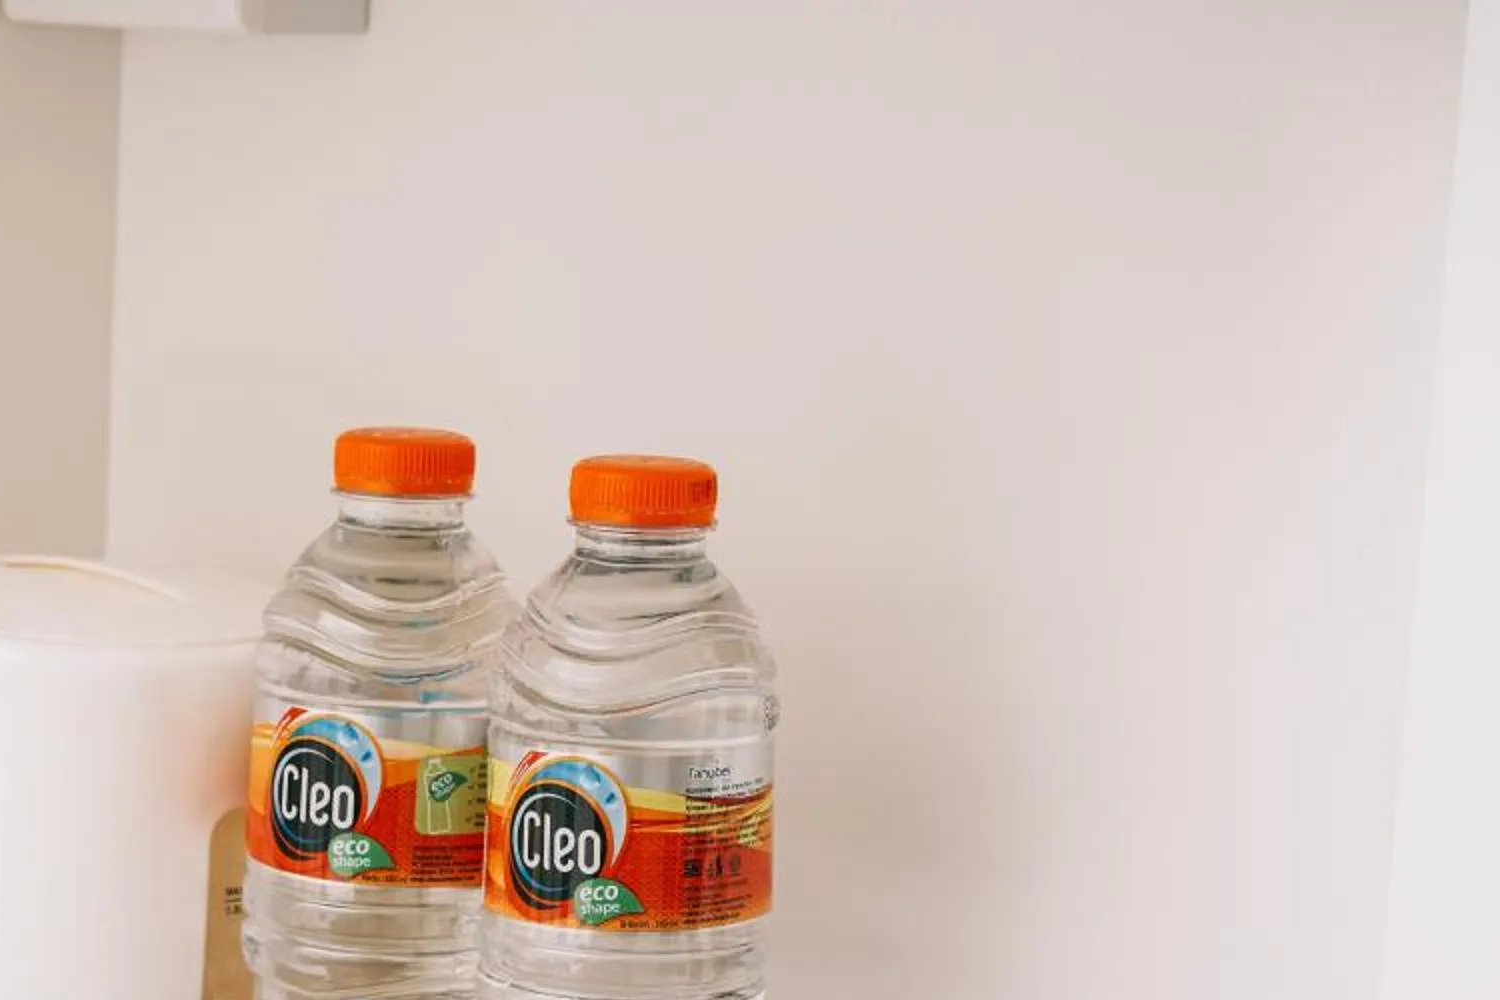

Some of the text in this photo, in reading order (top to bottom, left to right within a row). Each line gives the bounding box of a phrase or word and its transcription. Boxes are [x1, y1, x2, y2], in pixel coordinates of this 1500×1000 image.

[281, 763, 355, 829] Cleo
[332, 839, 370, 855] eco
[521, 810, 602, 876] Cleo
[332, 856, 371, 868] shape
[579, 885, 619, 901] eco
[580, 903, 620, 916] shape
